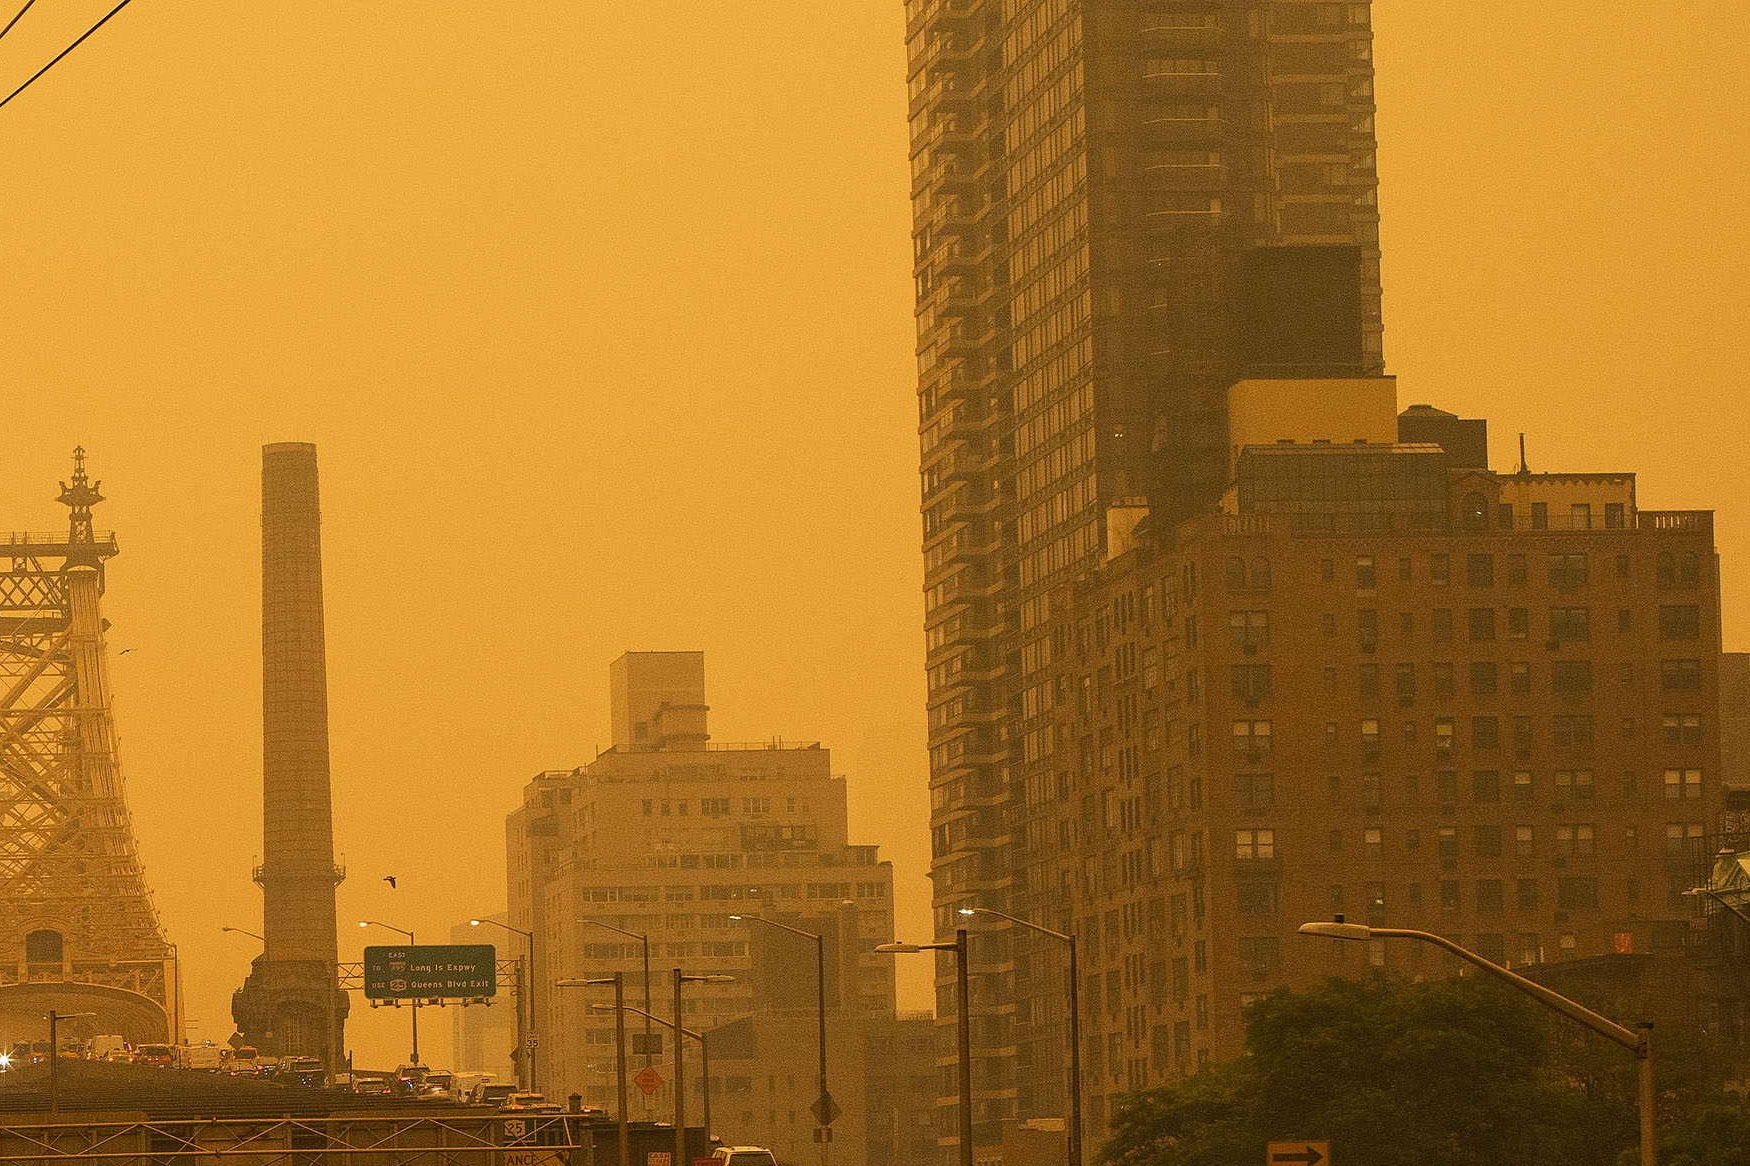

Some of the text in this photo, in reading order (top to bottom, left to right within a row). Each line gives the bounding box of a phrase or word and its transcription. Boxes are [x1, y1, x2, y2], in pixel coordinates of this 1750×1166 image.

[410, 964, 431, 974] Long
[448, 964, 476, 972] Expwy
[391, 980, 405, 990] 25
[526, 1040, 539, 1048] 35
[508, 1123, 522, 1133] 25
